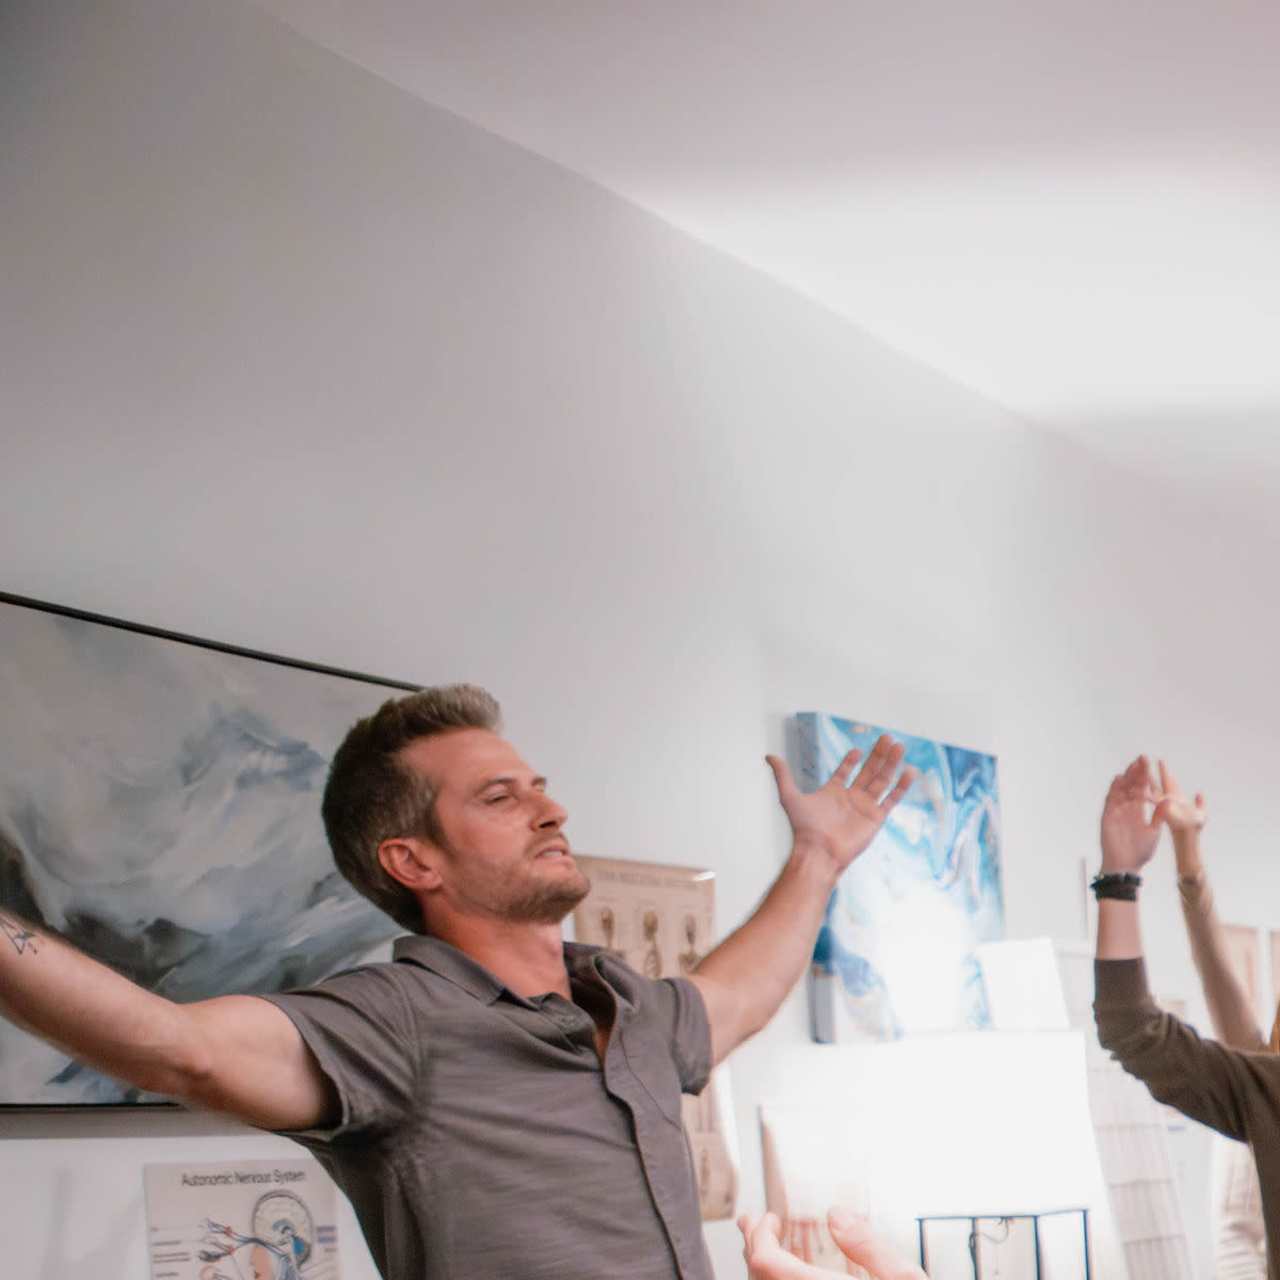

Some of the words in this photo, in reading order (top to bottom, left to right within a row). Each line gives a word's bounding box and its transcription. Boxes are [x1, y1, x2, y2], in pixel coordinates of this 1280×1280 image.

[181, 1171, 233, 1187] Autonomic
[234, 1170, 272, 1185] Nervous
[273, 1168, 305, 1186] System
